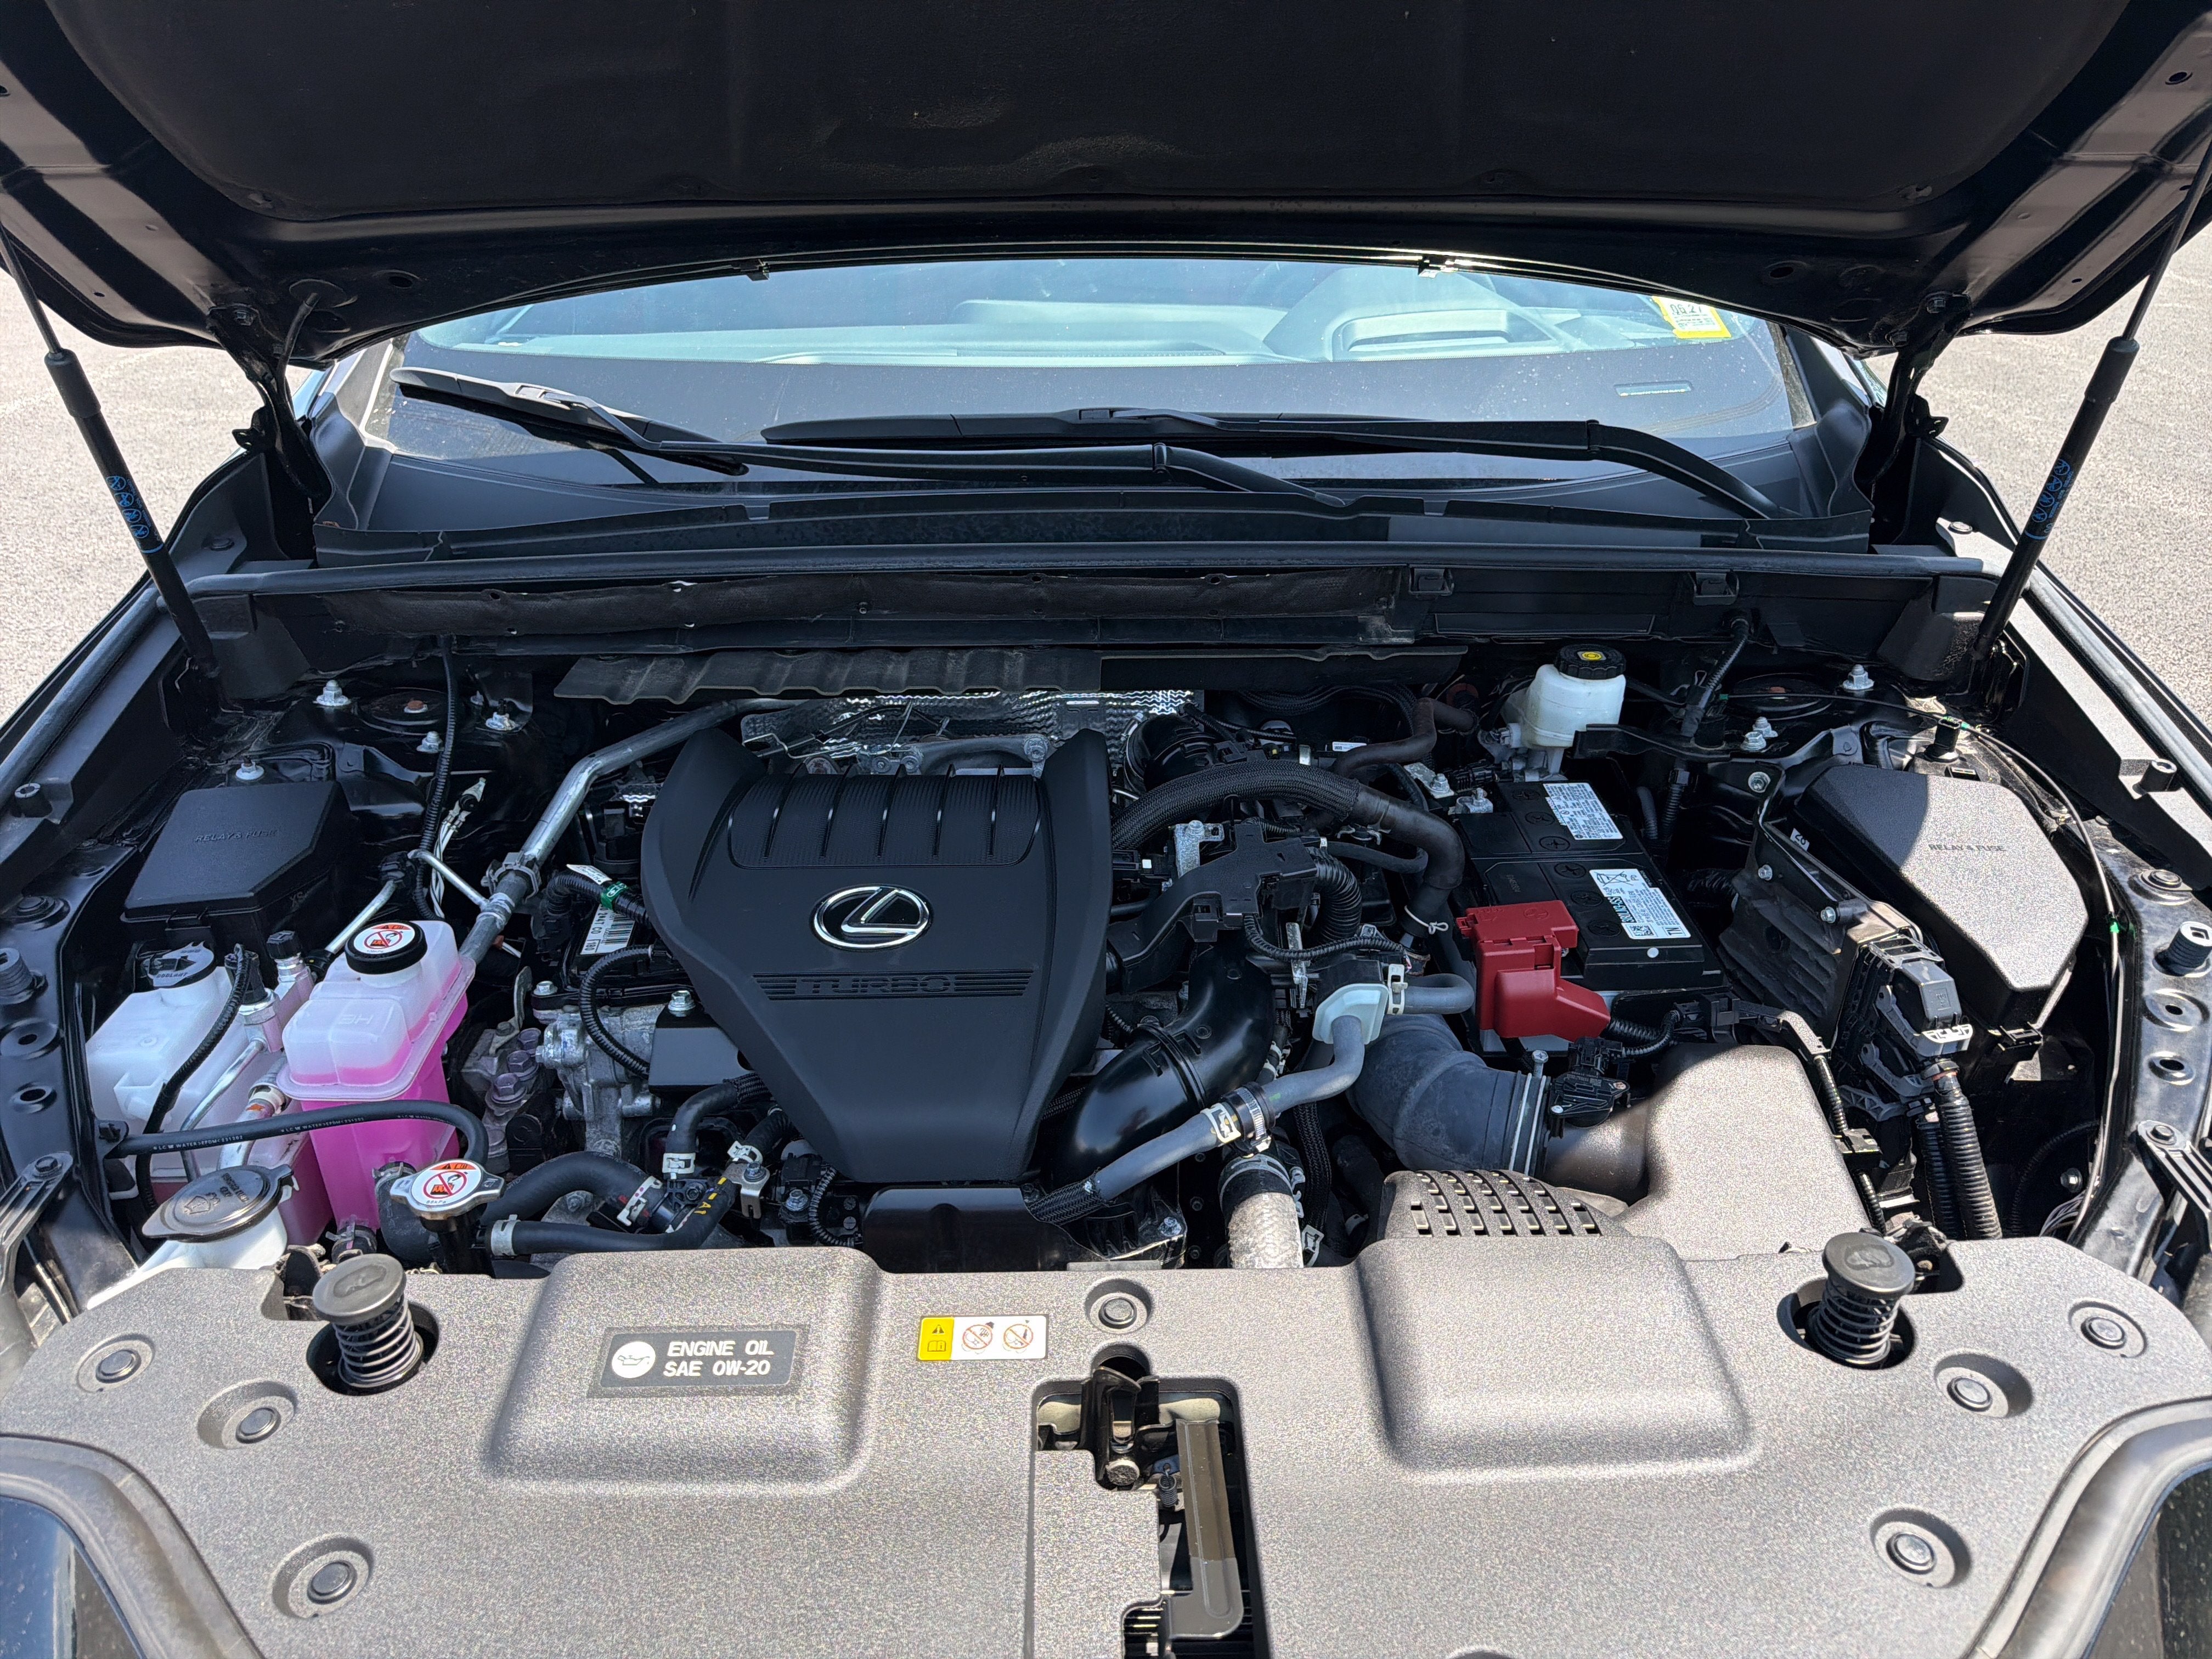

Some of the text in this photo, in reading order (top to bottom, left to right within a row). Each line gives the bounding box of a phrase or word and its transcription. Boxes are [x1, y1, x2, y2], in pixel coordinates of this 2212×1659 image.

[194, 833, 234, 843] RELAY
[800, 975, 951, 994] TURBO
[667, 1340, 774, 1357] ENGINE OIL
[663, 1359, 771, 1377] SAE 0W-20
